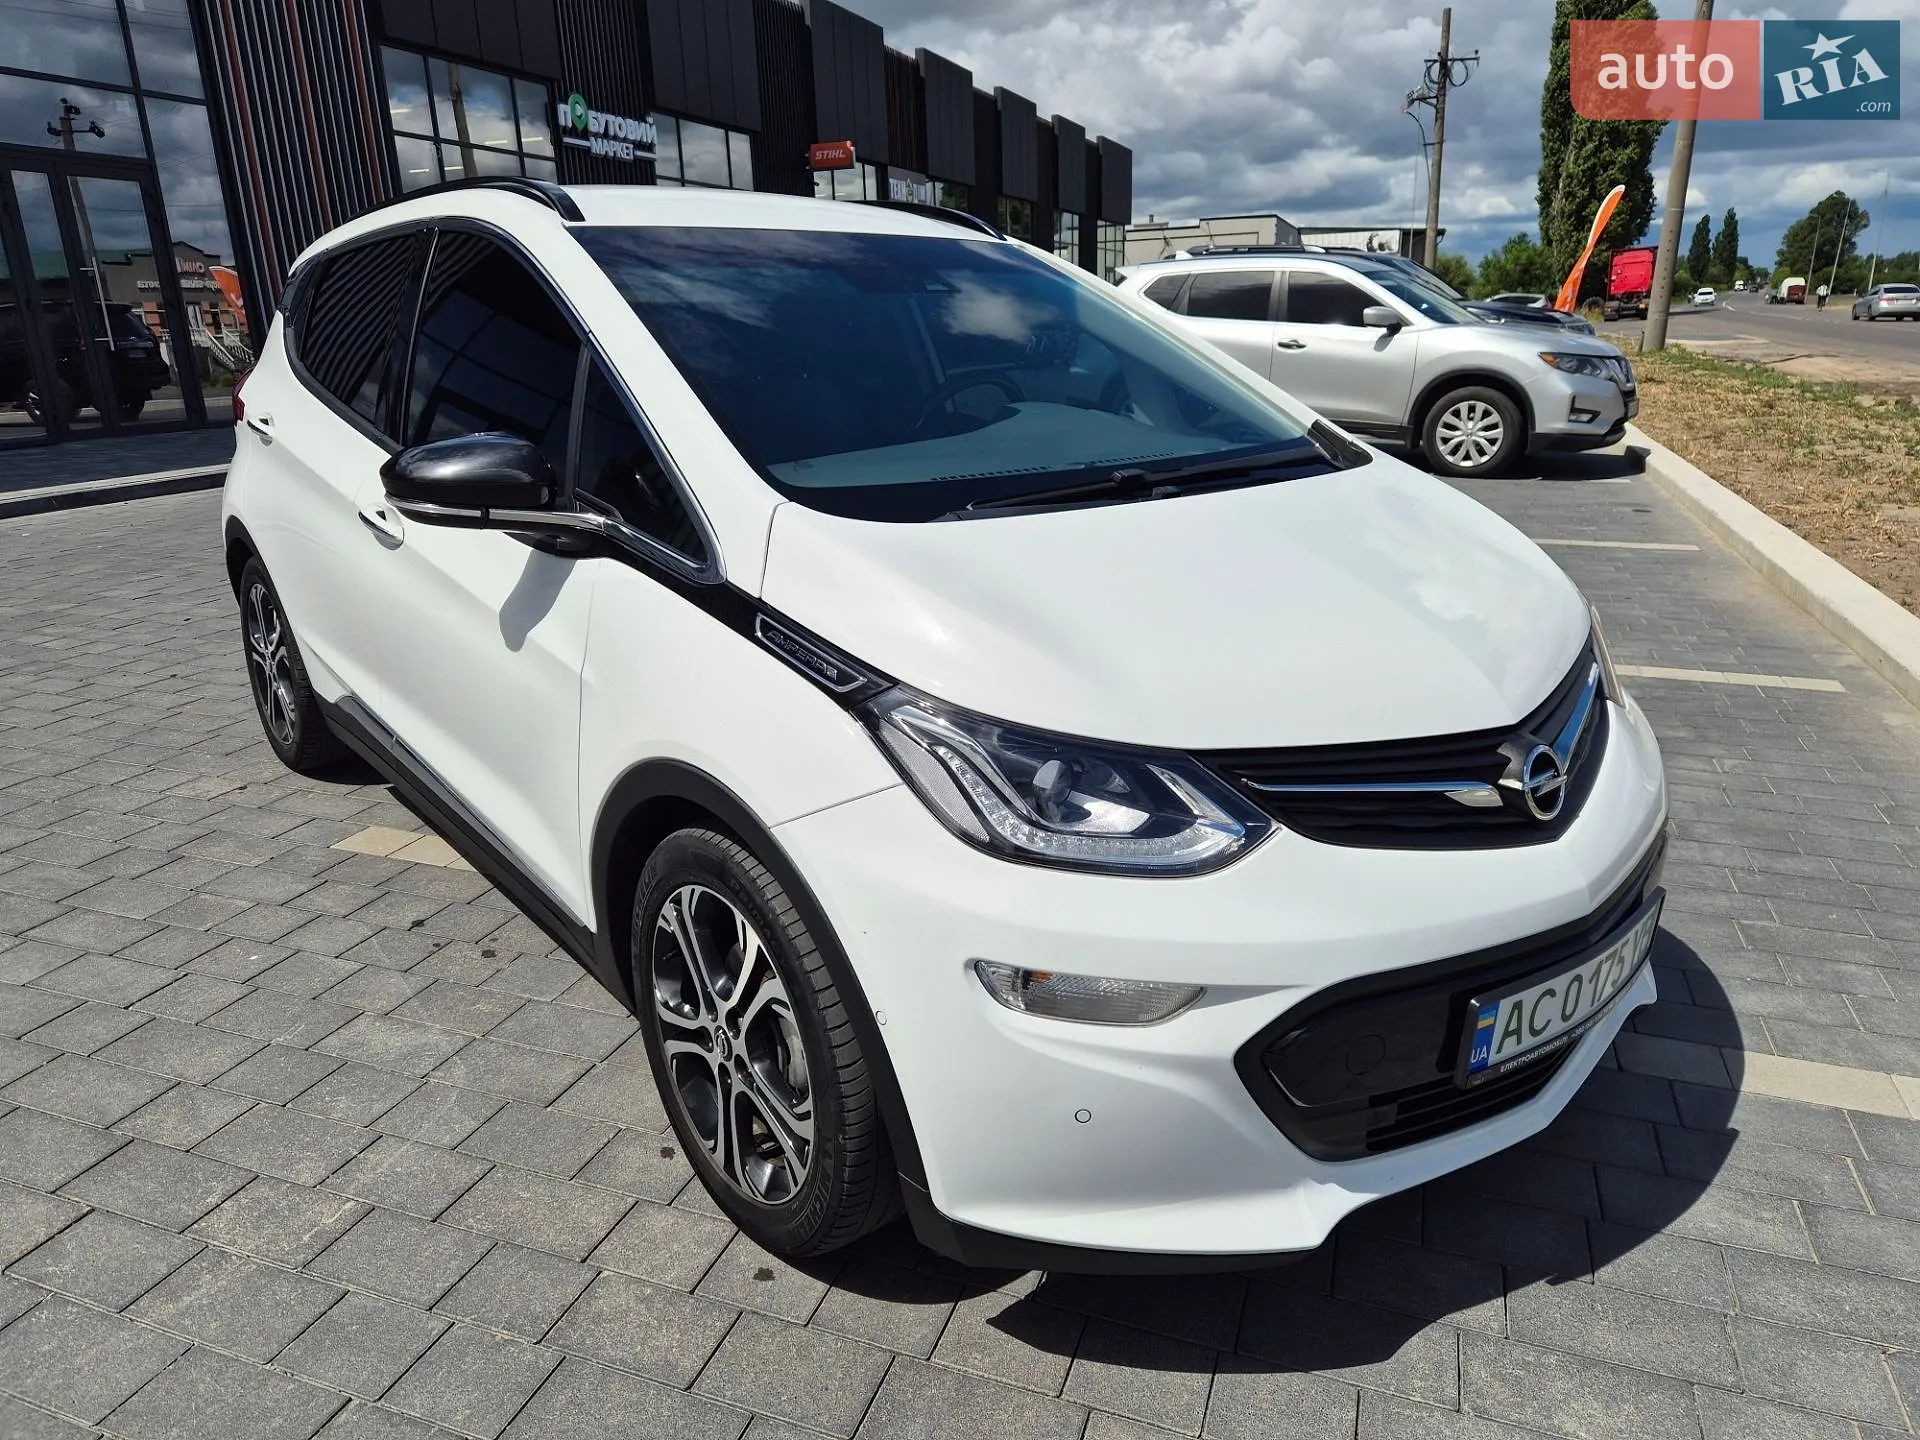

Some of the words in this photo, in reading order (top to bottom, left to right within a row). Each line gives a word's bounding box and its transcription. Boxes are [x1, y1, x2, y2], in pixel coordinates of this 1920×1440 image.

[589, 136, 634, 161] МАРКЕТ
[815, 149, 846, 160] STIHL
[1496, 987, 1557, 1055] AC
[1560, 938, 1631, 1023] 0175
[1471, 1045, 1488, 1064] UA
